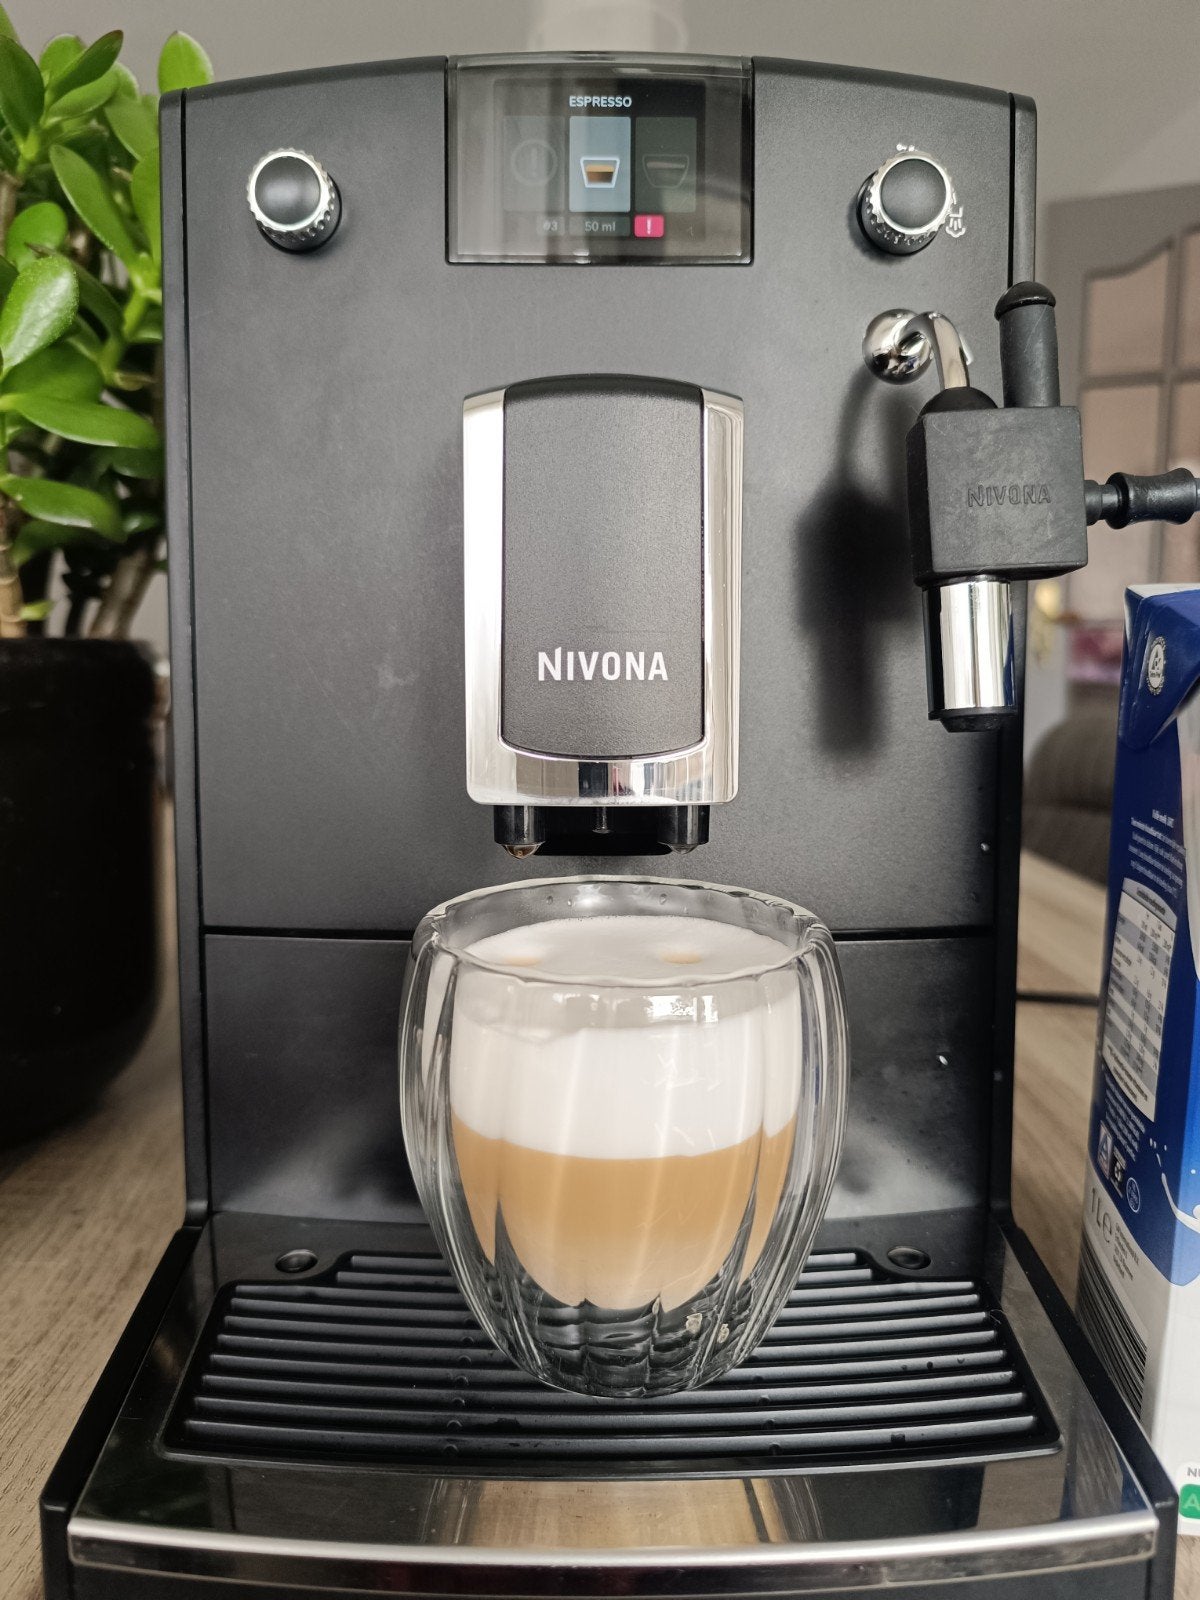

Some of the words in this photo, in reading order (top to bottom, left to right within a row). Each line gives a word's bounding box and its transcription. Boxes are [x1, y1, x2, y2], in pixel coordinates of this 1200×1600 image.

[569, 95, 632, 107] ESPRESSO
[584, 221, 599, 232] 50
[601, 221, 616, 232] ml
[967, 484, 1051, 508] NIVONA
[538, 646, 668, 681] NIVONA
